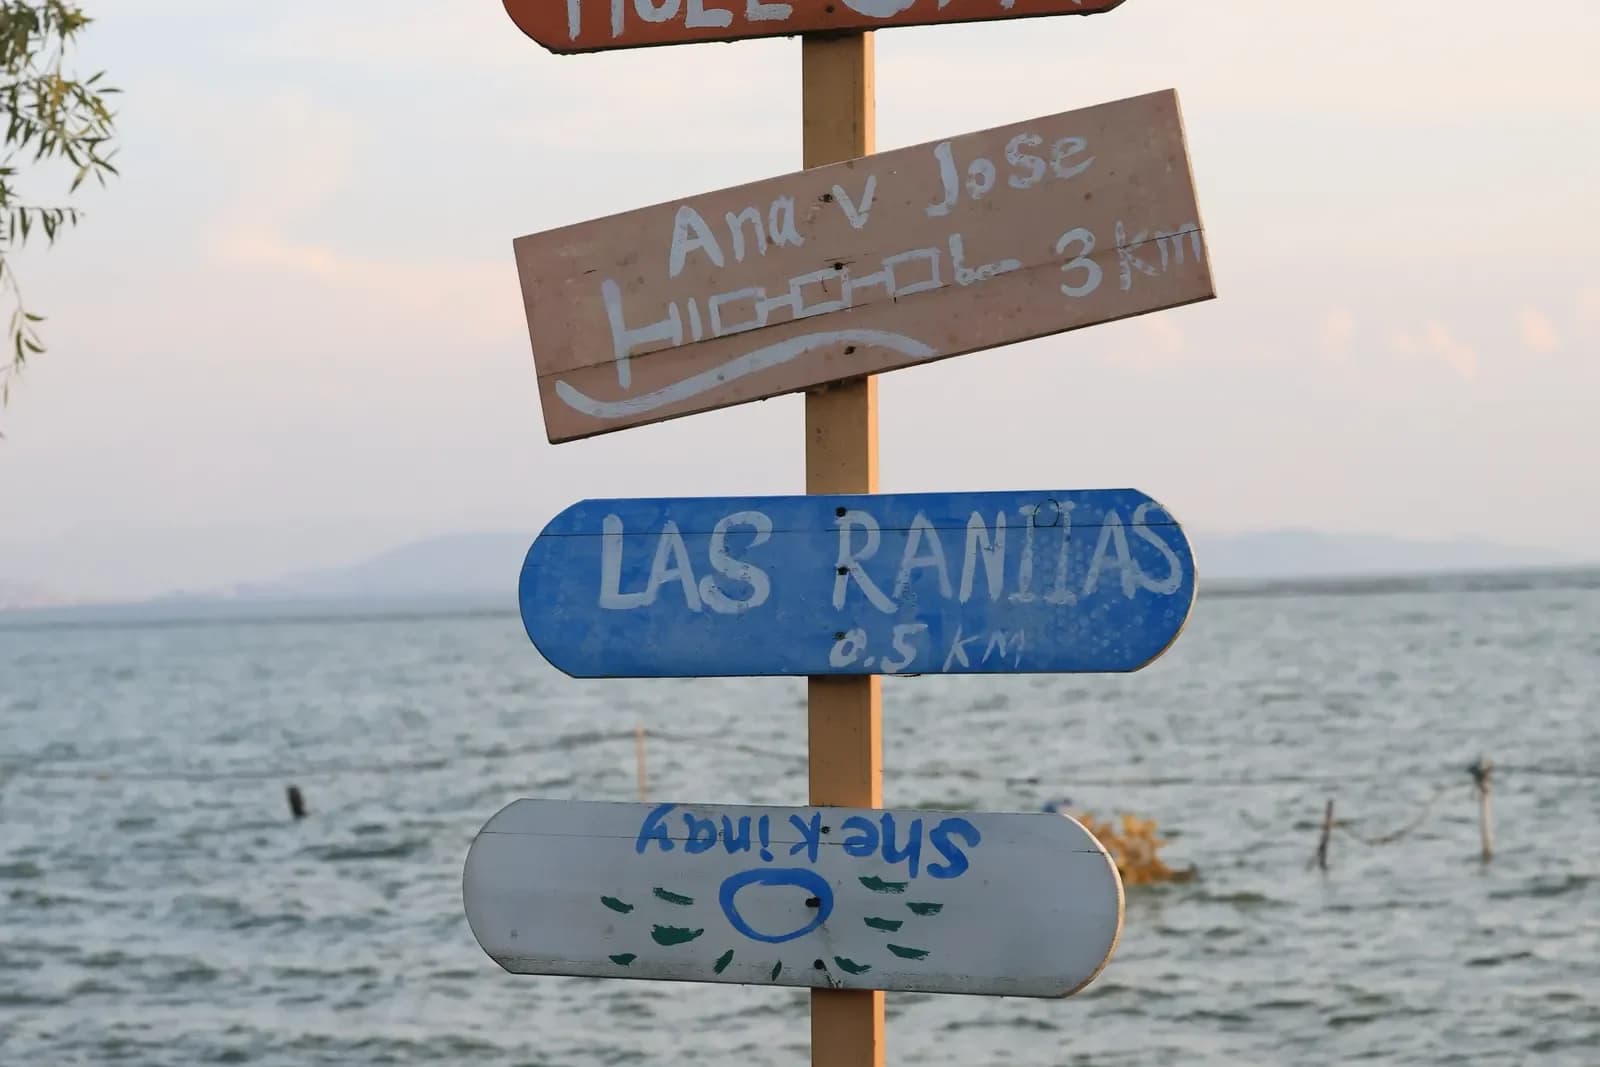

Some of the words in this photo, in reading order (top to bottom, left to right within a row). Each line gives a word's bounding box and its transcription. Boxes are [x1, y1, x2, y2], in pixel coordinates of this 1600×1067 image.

[668, 193, 806, 278] Ana
[1055, 227, 1103, 298] 3
[599, 509, 774, 615] LAS
[828, 623, 929, 674] 0.5
